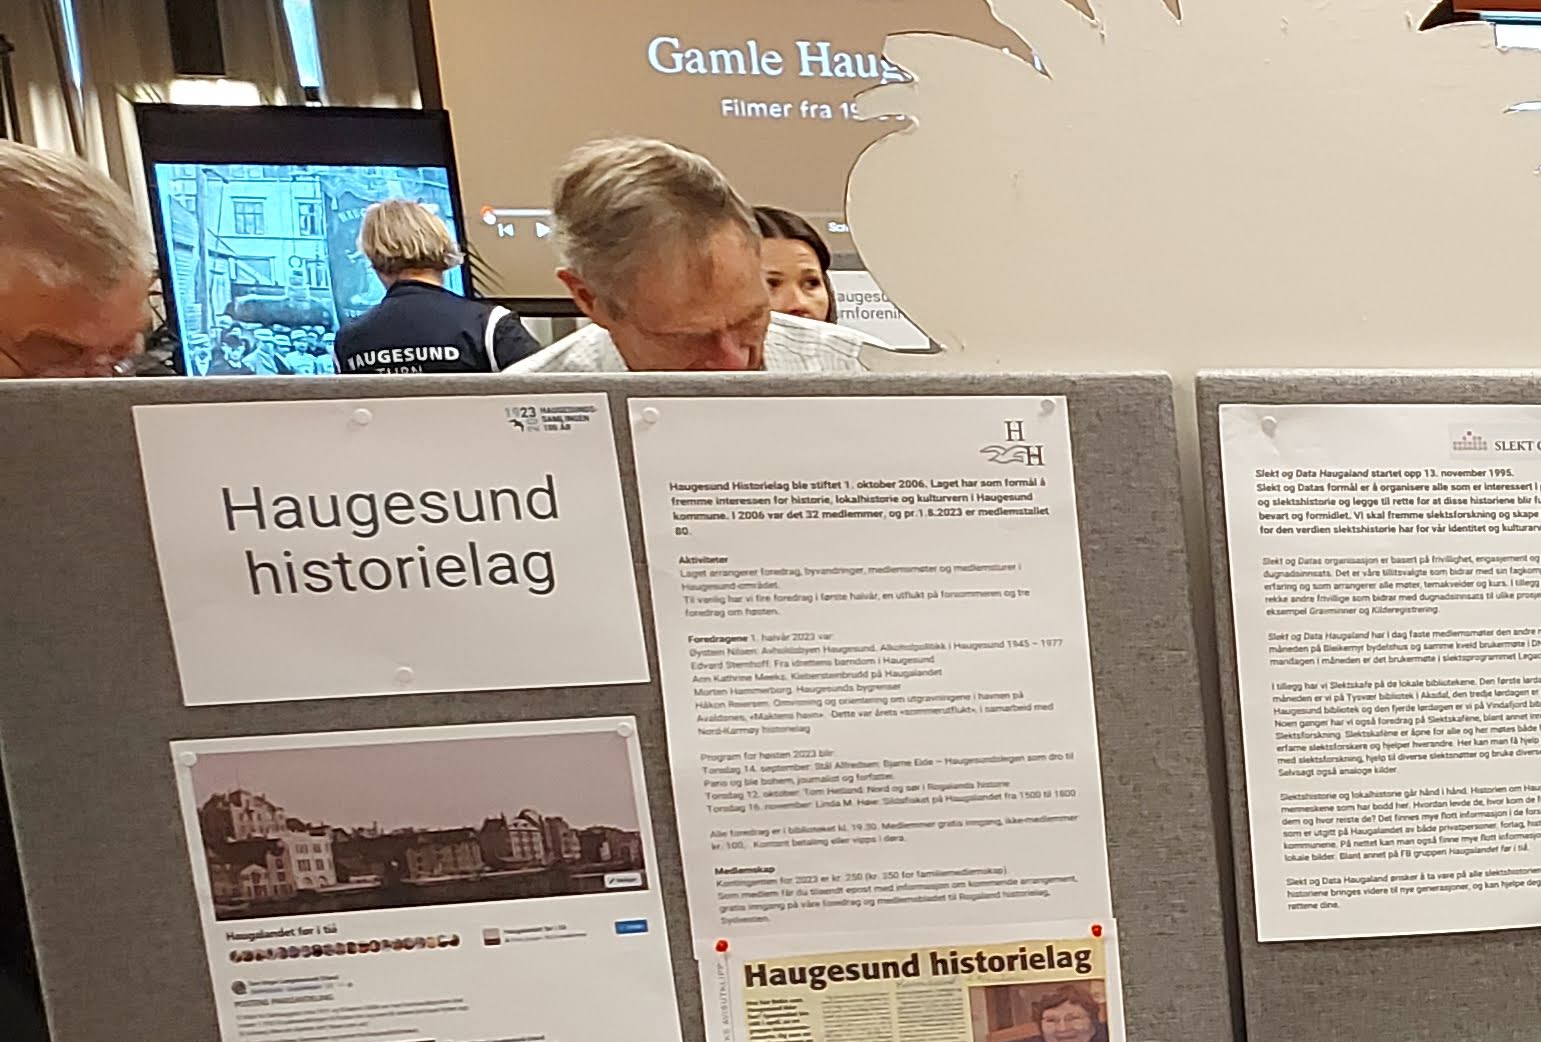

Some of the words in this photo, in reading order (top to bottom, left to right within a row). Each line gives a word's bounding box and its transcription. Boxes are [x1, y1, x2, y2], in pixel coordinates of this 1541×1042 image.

[648, 37, 783, 75] Gamle
[721, 99, 792, 118] Filmer
[800, 100, 832, 118] fra
[1005, 420, 1024, 442] H
[1494, 440, 1534, 451] SLEKT
[1024, 445, 1045, 466] H
[1255, 469, 1279, 477] Slekt
[1281, 471, 1293, 479] og
[1295, 469, 1316, 477] Data
[1319, 469, 1368, 477] Haugaland
[1403, 470, 1421, 479] opp
[669, 482, 729, 491] Haugesund
[731, 481, 789, 490] Historielag
[791, 480, 808, 489] ble
[810, 480, 841, 489] stiftet
[856, 480, 895, 488] oktober
[930, 479, 958, 489] Laget
[960, 478, 977, 487] har
[1004, 477, 1037, 486] formål
[1256, 483, 1280, 491] Slekt
[1283, 485, 1295, 493] og
[1297, 483, 1324, 491] Datas
[1326, 482, 1357, 491] formål
[1431, 482, 1448, 490] alle
[221, 474, 559, 538] Haugesund
[715, 497, 770, 505] interessen
[773, 495, 787, 504] for
[834, 494, 899, 503] lokalhistorie
[901, 495, 914, 504] og
[916, 493, 968, 502] kulturvern
[976, 492, 1033, 501] Haugesund
[1257, 499, 1270, 508] og
[1272, 497, 1336, 505] slektshistorie
[1338, 499, 1350, 507] og
[1352, 498, 1378, 507] legge
[1380, 496, 1390, 505] til
[1392, 497, 1414, 505] rette
[1416, 496, 1429, 505] for
[1443, 496, 1467, 504] disse
[1469, 496, 1515, 504] historiene
[1517, 496, 1531, 504] blir
[1258, 512, 1288, 520] bevart
[1291, 513, 1303, 521] og
[1353, 511, 1363, 519] Vi
[1366, 510, 1385, 519] skal
[1387, 511, 1423, 519] fremme
[1426, 510, 1496, 518] slektsforskning
[1498, 511, 1510, 520] og
[246, 541, 555, 596] historielag
[226, 927, 295, 942] Haugalandet
[744, 952, 921, 991] Haugesund
[929, 945, 1093, 976] historielag
